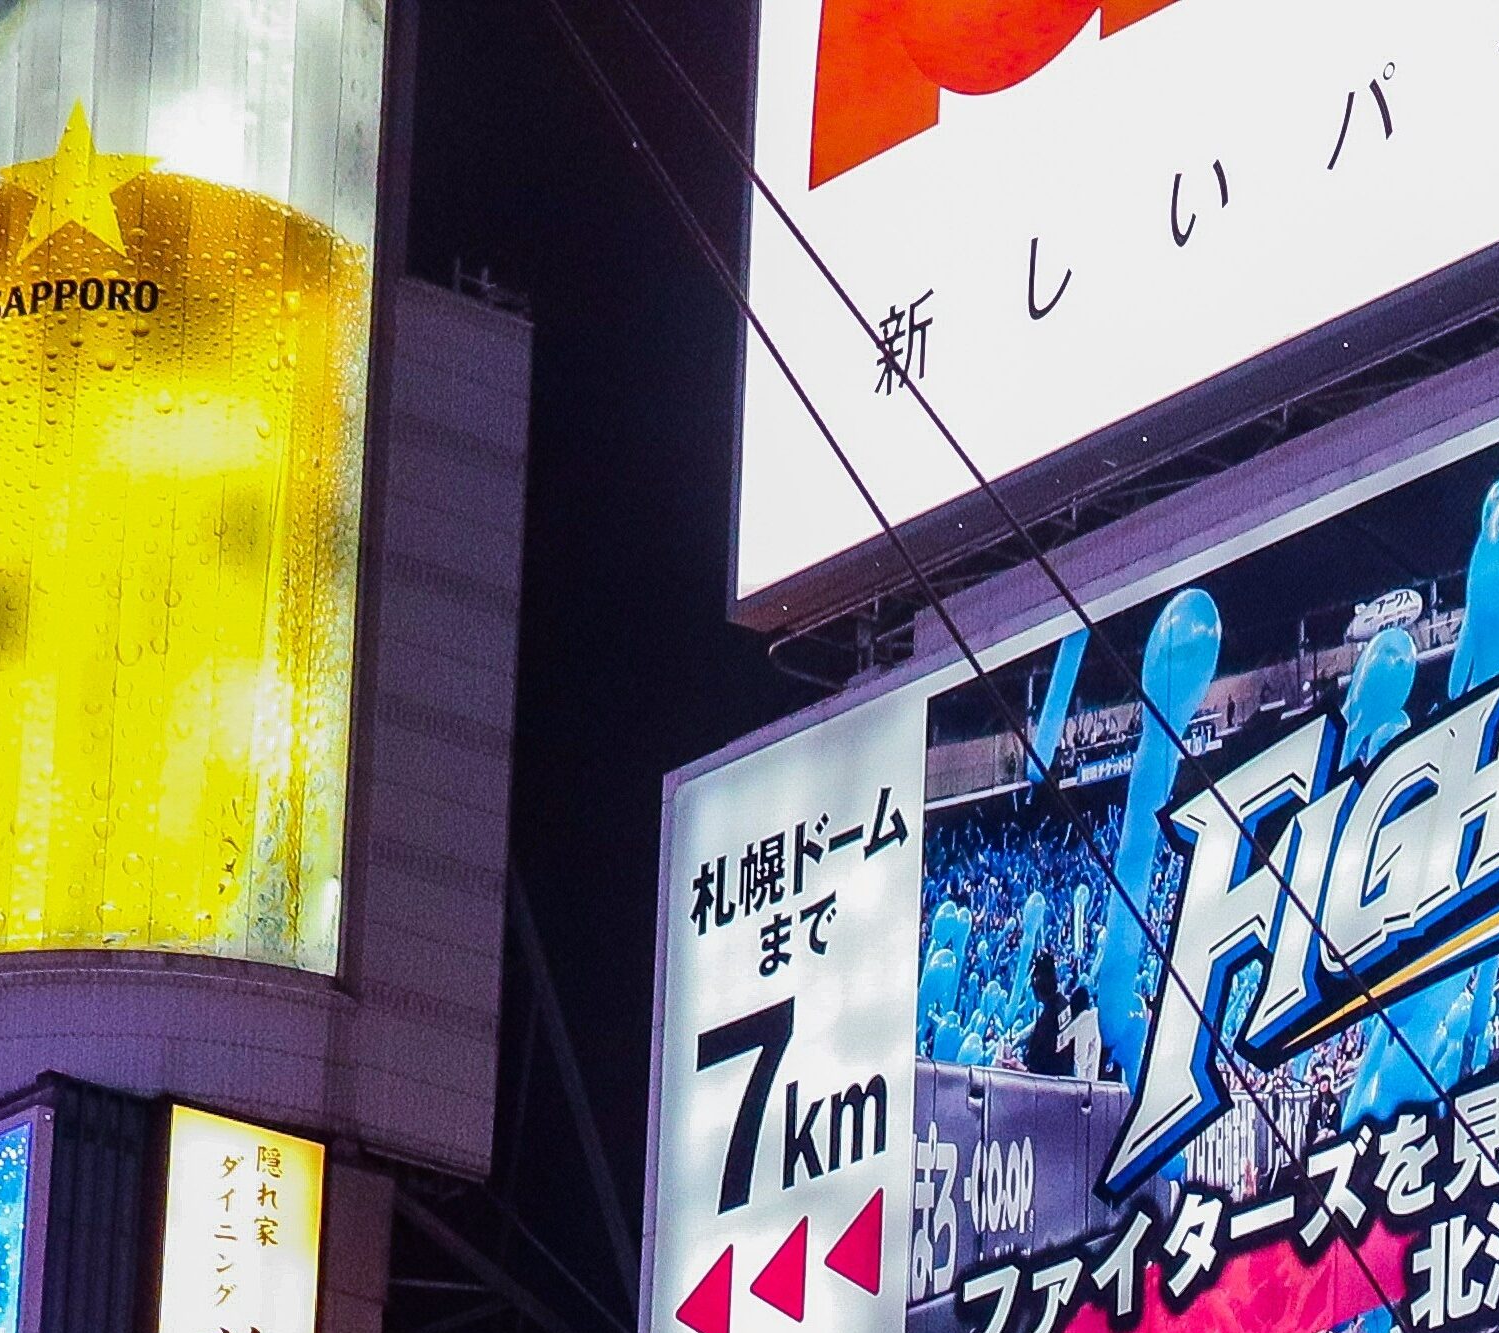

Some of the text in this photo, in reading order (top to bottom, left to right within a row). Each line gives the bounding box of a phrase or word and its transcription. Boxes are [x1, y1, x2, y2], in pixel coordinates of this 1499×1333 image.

[690, 786, 908, 936] 札幌ドーム
[758, 890, 838, 978] まで
[695, 997, 888, 1216] 7km
[214, 1154, 244, 1307] ダイニング
[254, 1146, 283, 1247] 隠れ家
